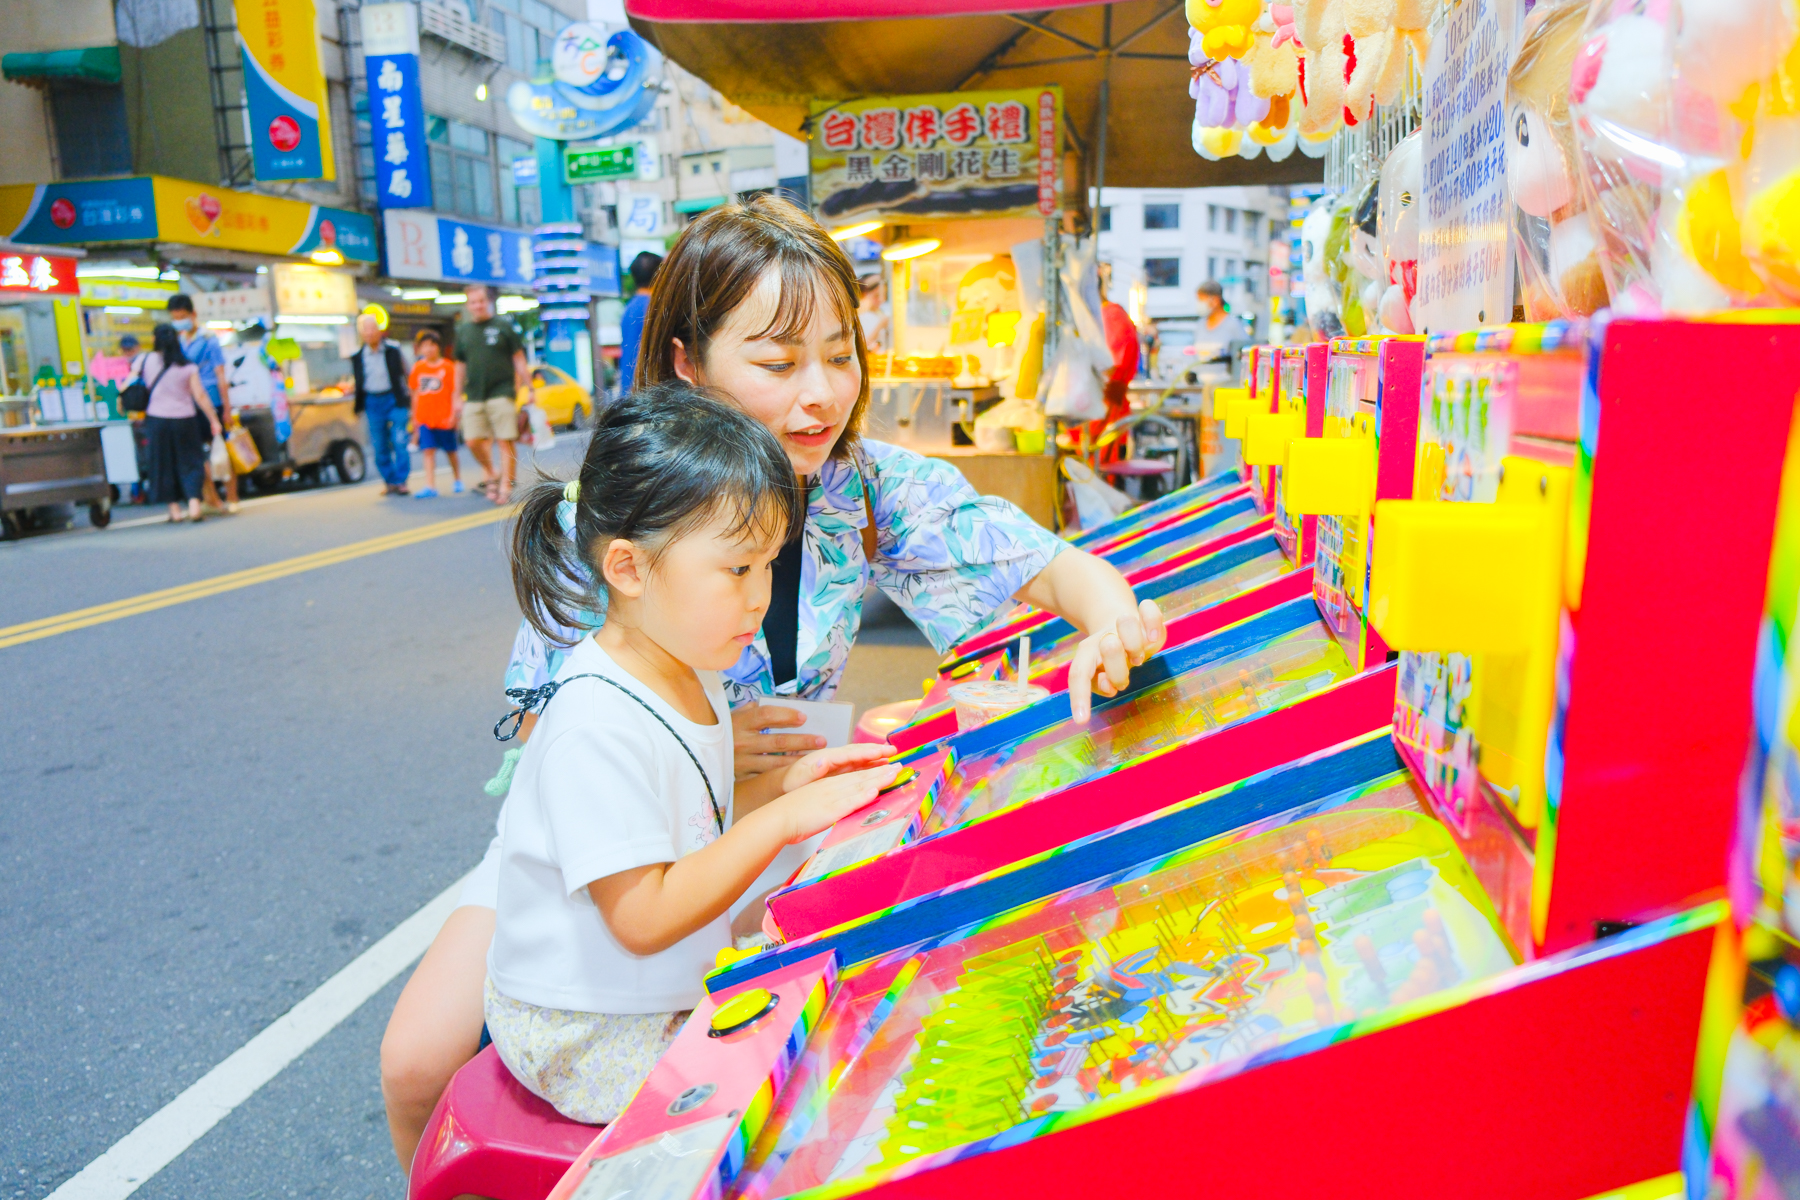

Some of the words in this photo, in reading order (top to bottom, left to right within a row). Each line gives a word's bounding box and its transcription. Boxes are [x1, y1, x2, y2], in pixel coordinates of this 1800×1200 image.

[821, 103, 1026, 149] 台灣伴手禮
[846, 150, 1020, 181] 黑金剛花生
